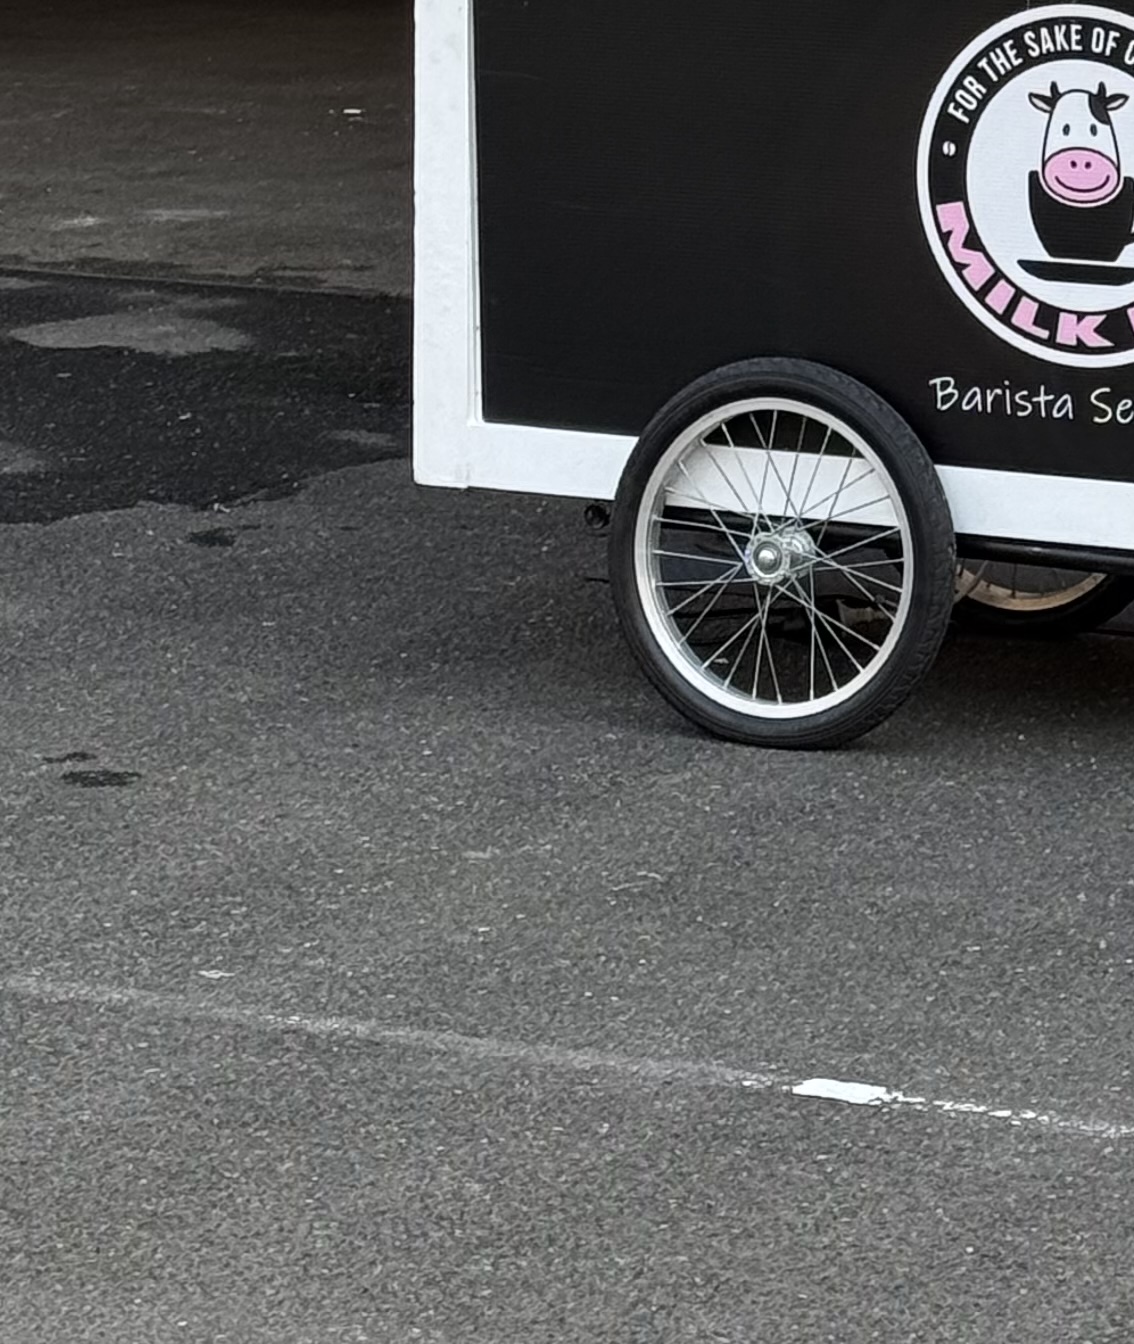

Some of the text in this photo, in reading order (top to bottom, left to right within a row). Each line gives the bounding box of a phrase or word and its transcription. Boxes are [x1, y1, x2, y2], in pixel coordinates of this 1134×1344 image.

[947, 74, 987, 123] FOR
[978, 40, 1024, 82] THE
[1024, 23, 1083, 57] SAKE
[1091, 26, 1121, 60] OF
[935, 201, 1115, 348] MILK
[928, 376, 1074, 421] Barista
